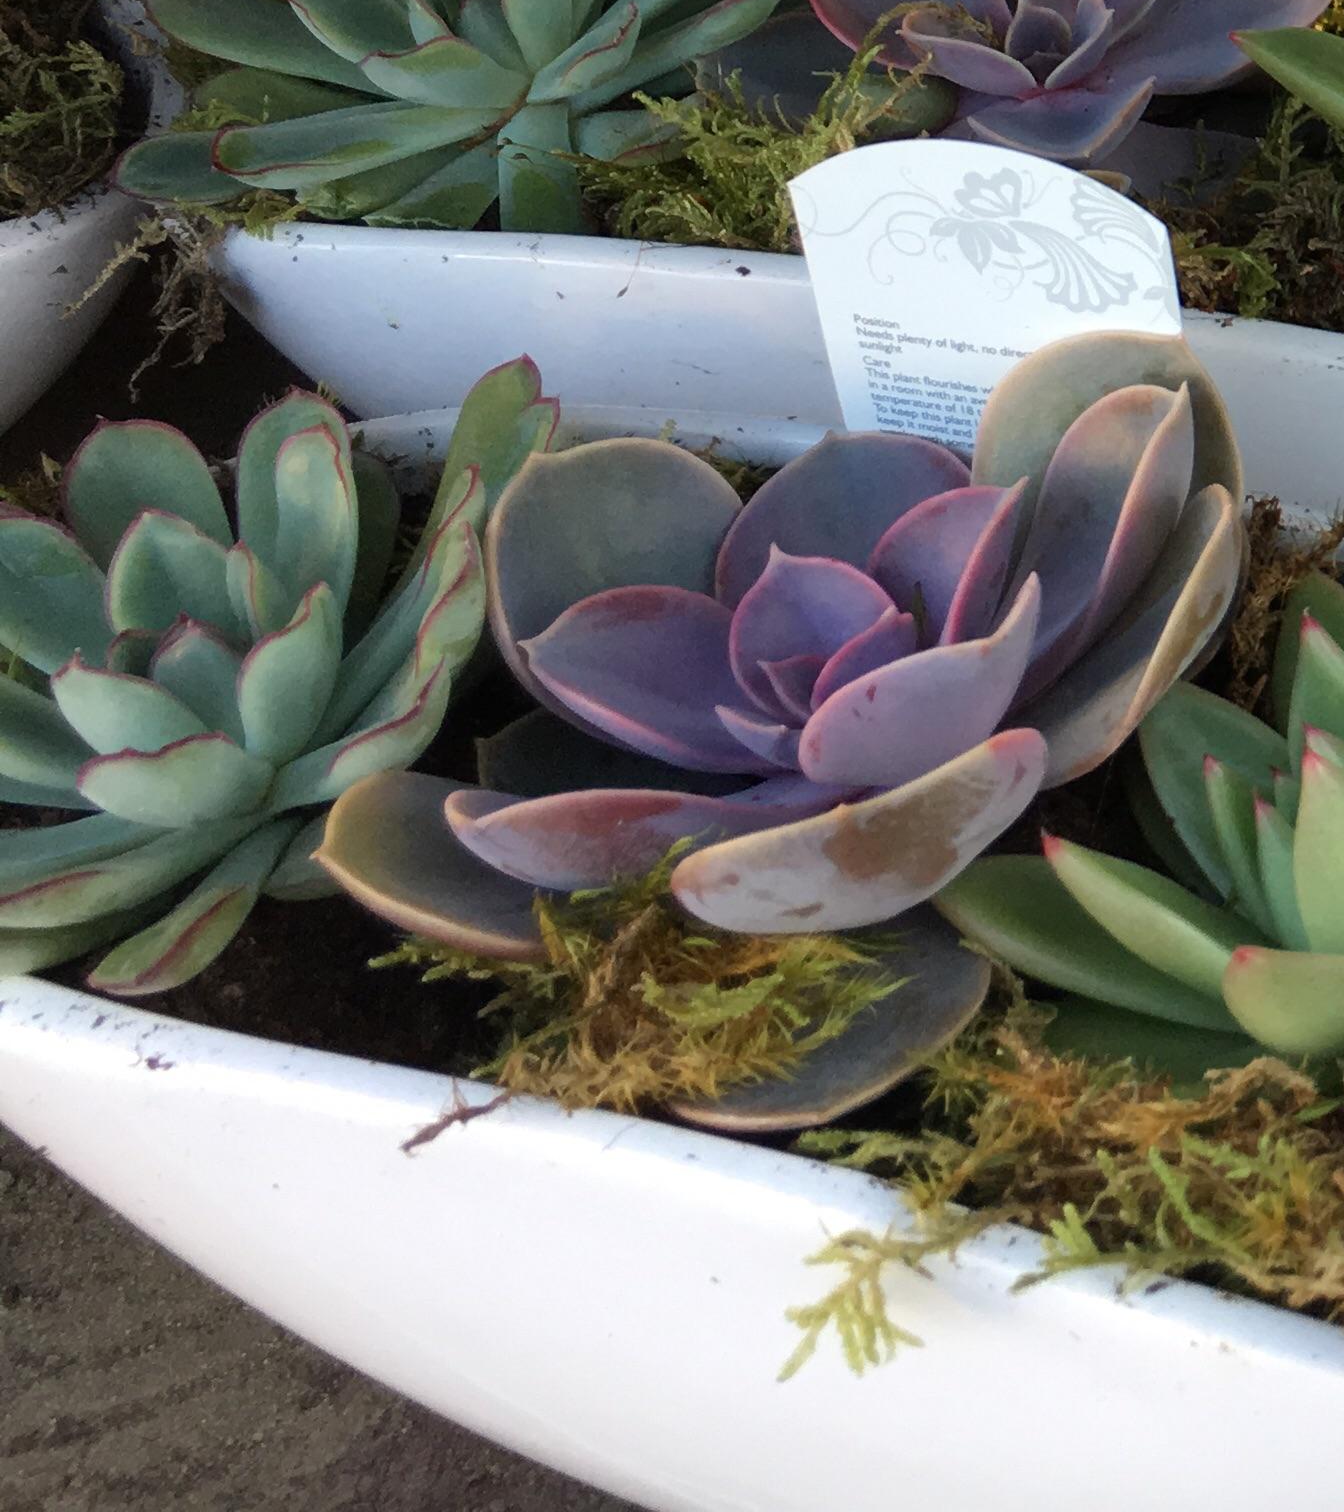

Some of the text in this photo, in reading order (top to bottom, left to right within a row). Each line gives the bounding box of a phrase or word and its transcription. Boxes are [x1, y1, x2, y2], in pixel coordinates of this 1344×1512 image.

[853, 314, 900, 329] Position
[856, 327, 893, 340] Needs
[897, 333, 933, 347] plenty
[859, 340, 903, 355] sunlight
[863, 356, 891, 368] Care
[866, 368, 890, 379] This
[892, 372, 921, 385] plant
[924, 376, 978, 392] flourishes
[872, 392, 942, 410] temperature
[892, 385, 923, 395] room
[926, 389, 951, 400] with
[892, 407, 918, 418] keep
[922, 411, 941, 421] this
[944, 414, 972, 427] plant
[877, 416, 905, 428] keep
[919, 423, 949, 434] moist
[953, 427, 972, 437] and
